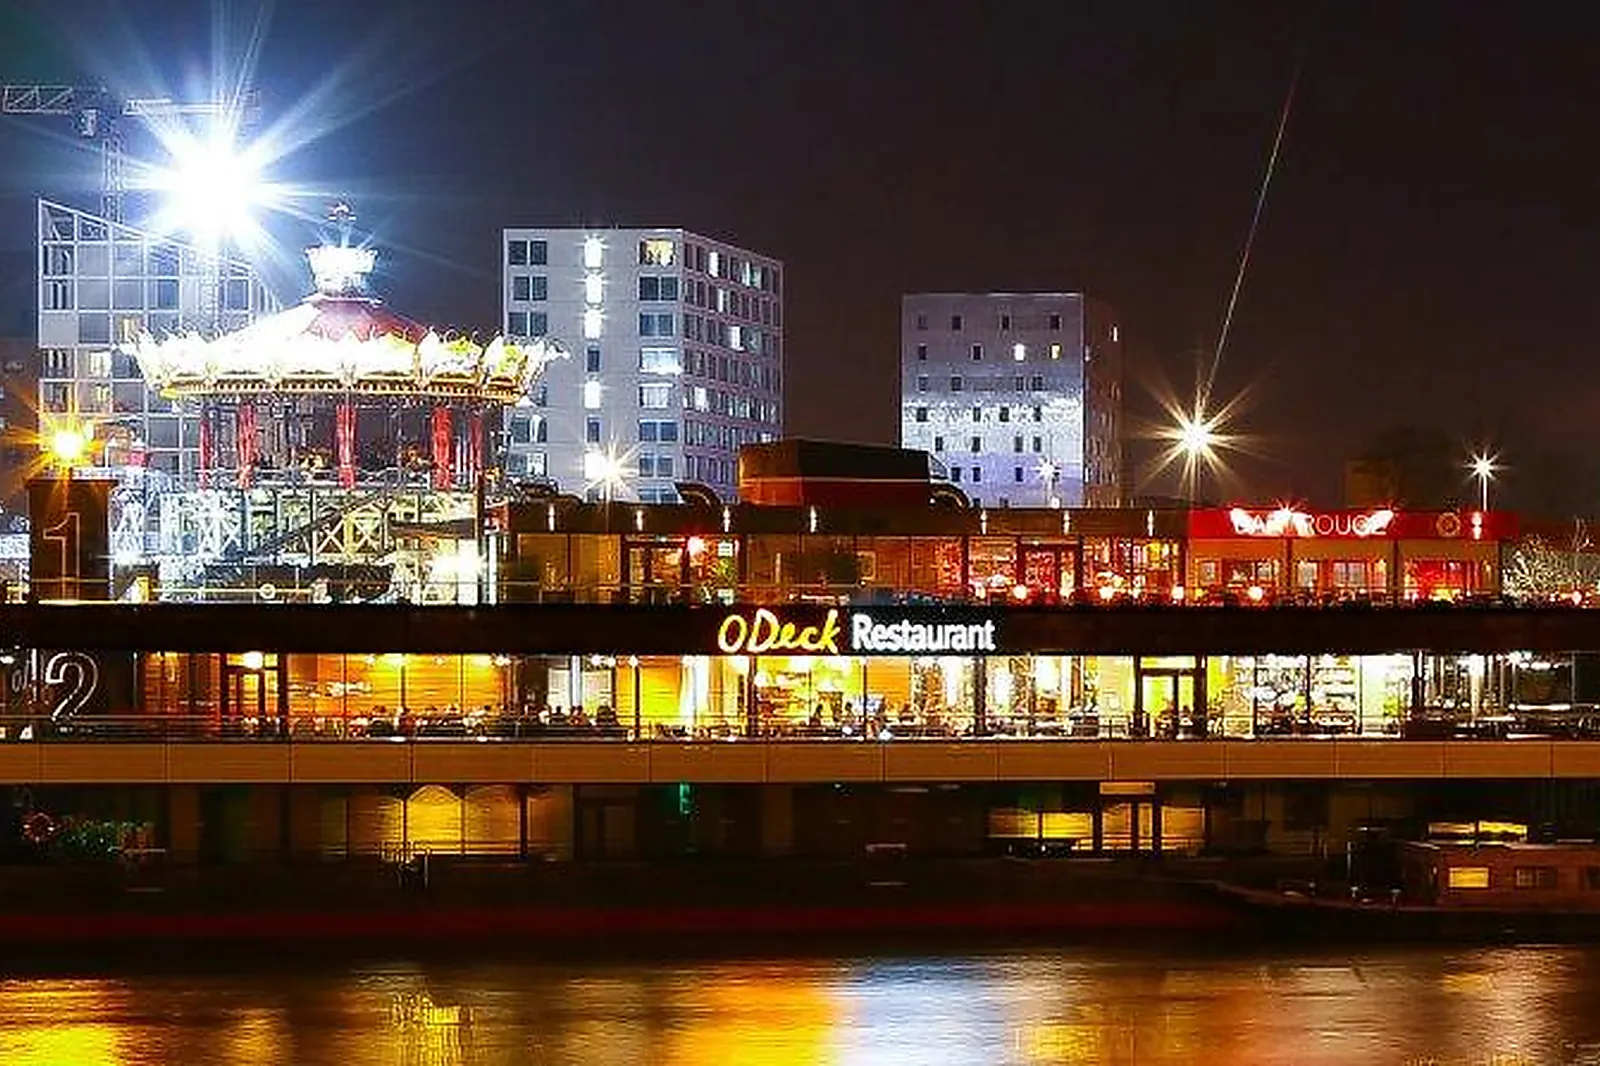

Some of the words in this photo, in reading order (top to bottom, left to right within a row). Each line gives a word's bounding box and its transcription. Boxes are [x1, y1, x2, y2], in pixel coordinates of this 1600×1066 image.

[43, 512, 80, 600] 1
[851, 613, 996, 651] Restaurant
[45, 651, 98, 725] 2
